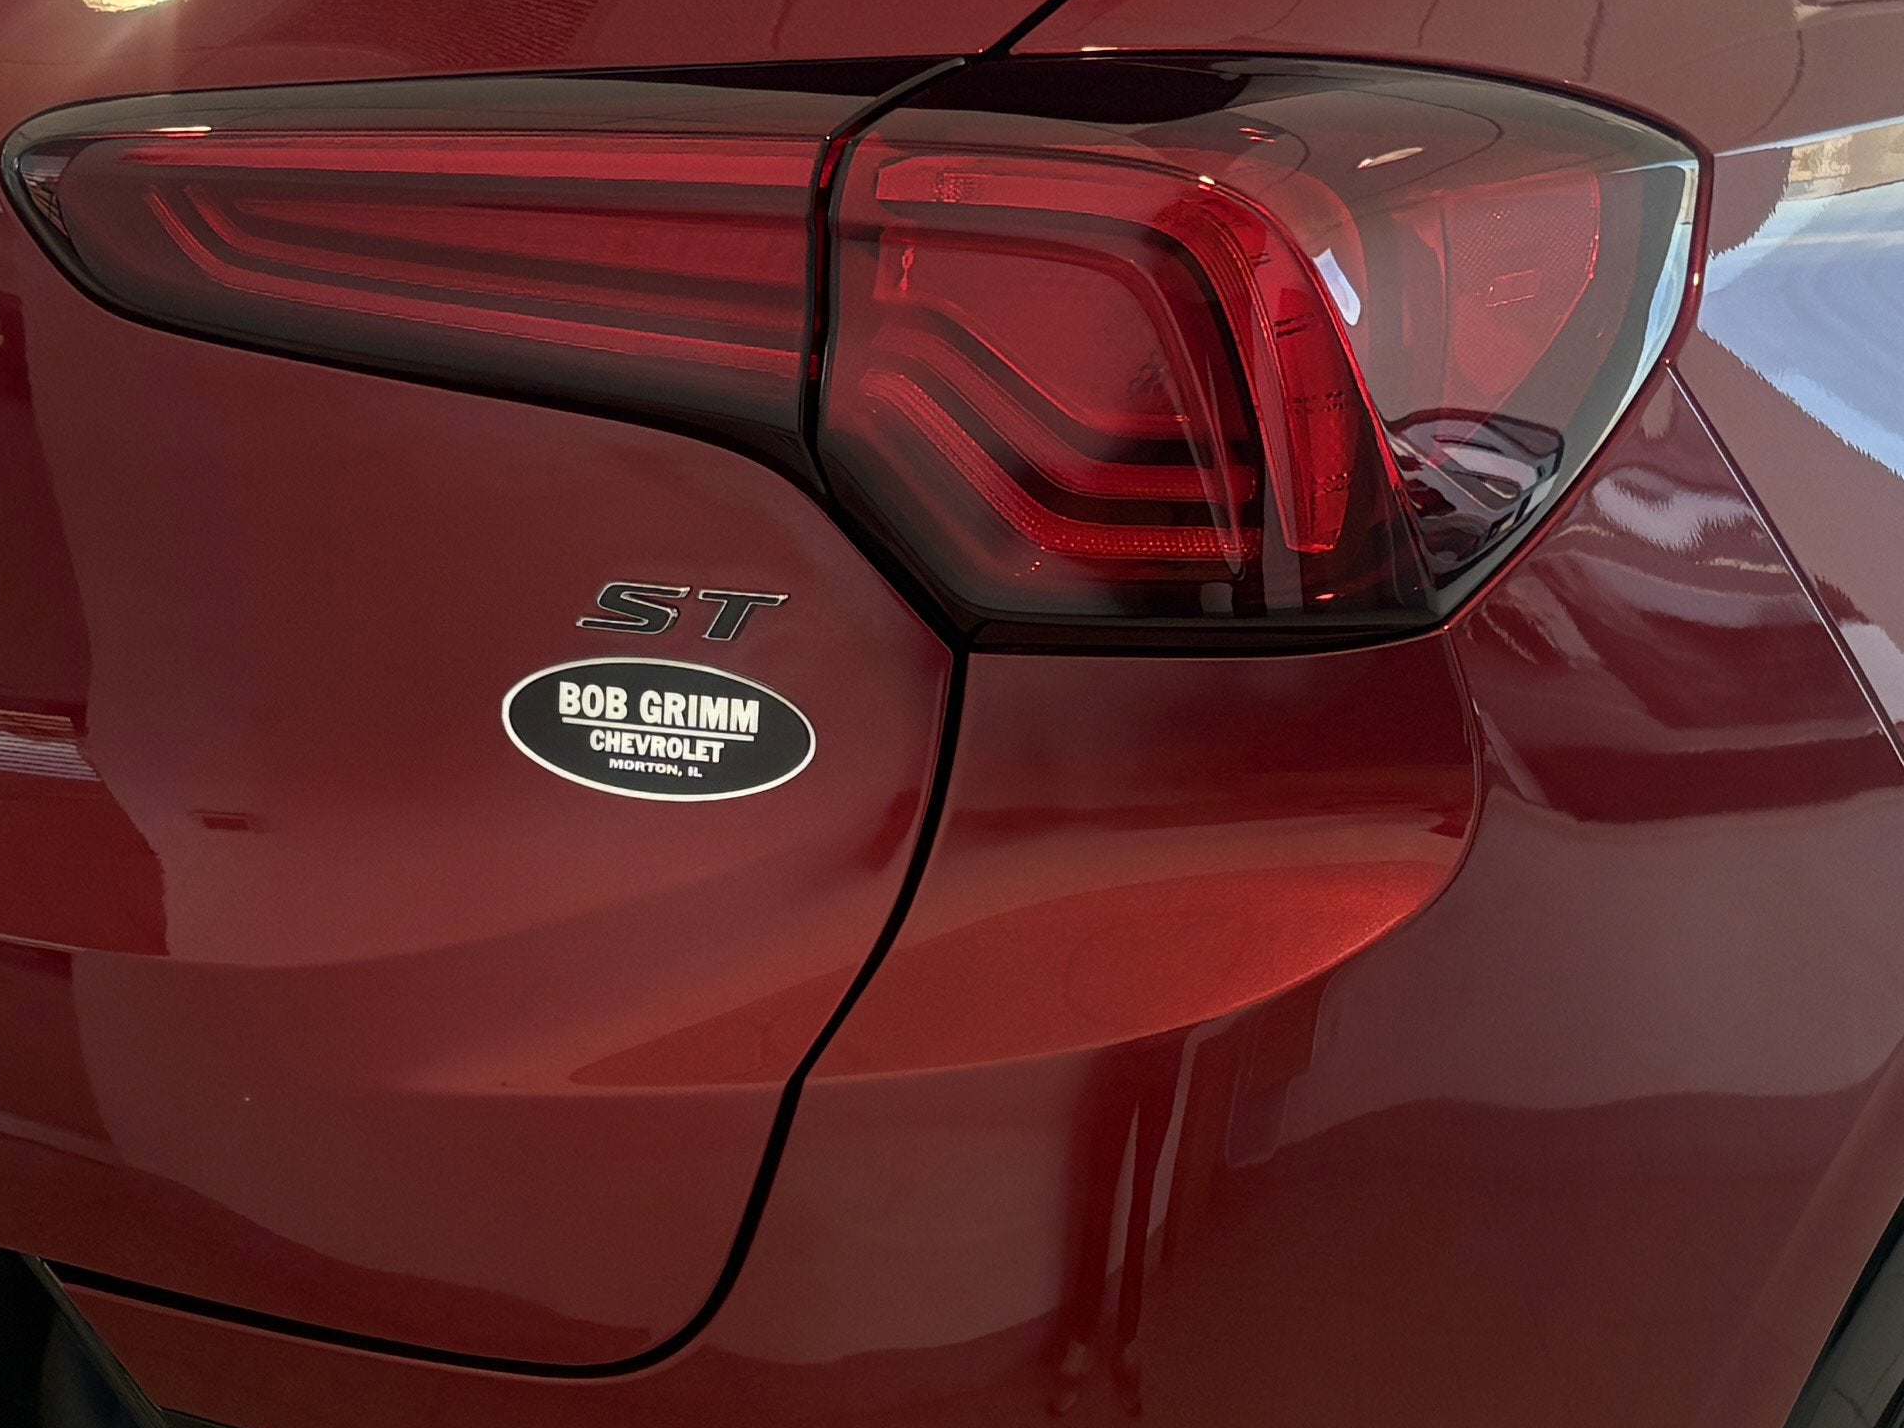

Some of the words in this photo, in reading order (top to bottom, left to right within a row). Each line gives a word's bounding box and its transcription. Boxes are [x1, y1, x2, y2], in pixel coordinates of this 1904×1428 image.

[576, 582, 788, 641] ST
[558, 681, 628, 720] BOB
[639, 690, 760, 734] GRIMM
[589, 729, 725, 763] CHEVROLET
[608, 758, 683, 778] MORTON,
[687, 765, 703, 778] IL
